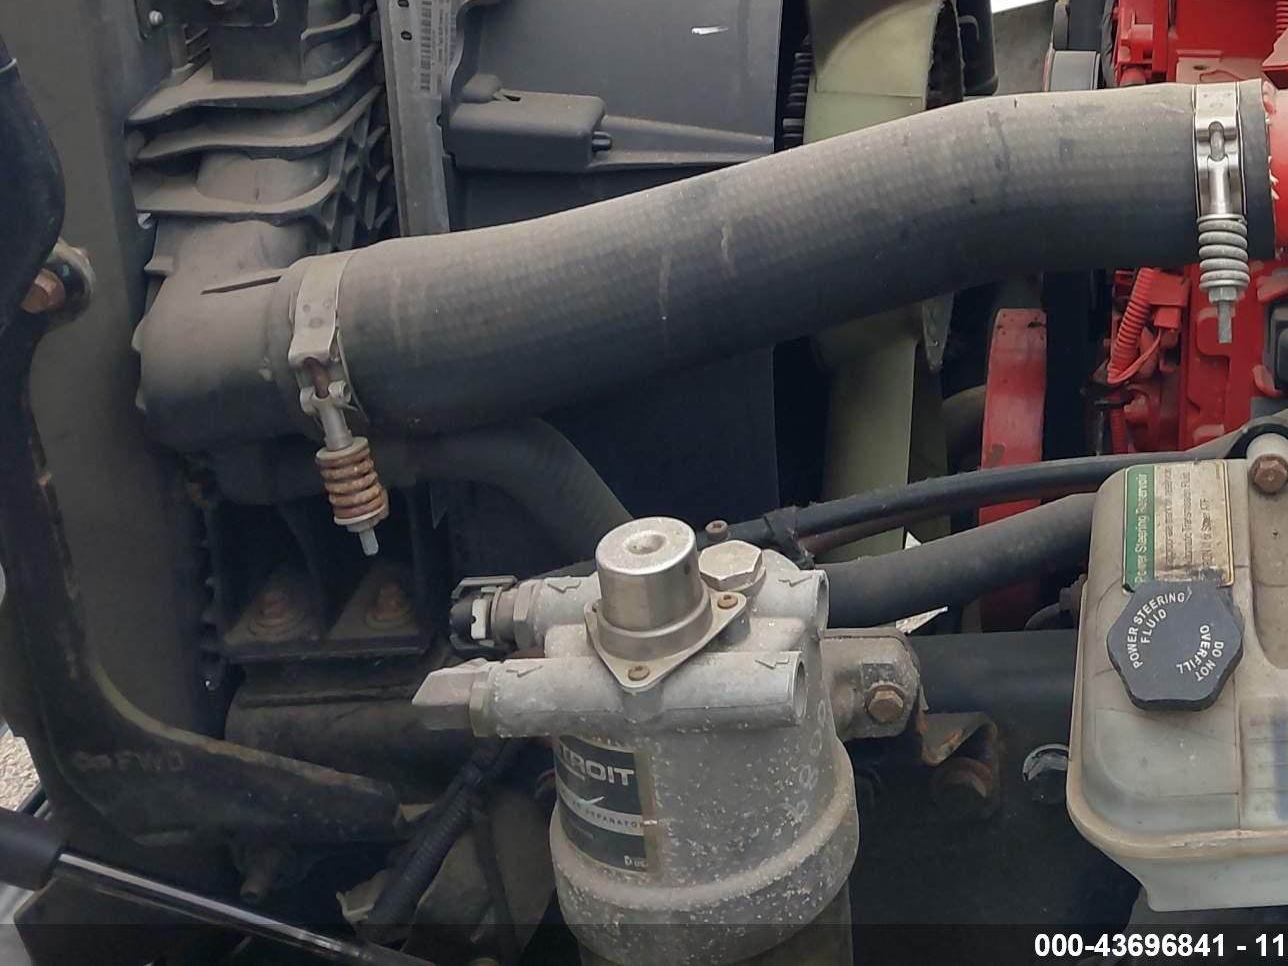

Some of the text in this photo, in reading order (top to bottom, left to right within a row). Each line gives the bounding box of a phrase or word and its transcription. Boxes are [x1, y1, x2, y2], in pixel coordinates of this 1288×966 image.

[1134, 514, 1150, 553] Steering
[1127, 592, 1185, 669] POWER STEERING
[1140, 608, 1167, 644] FLUID
[1176, 624, 1212, 674] OVERFILL
[1195, 641, 1225, 682] DO NOT
